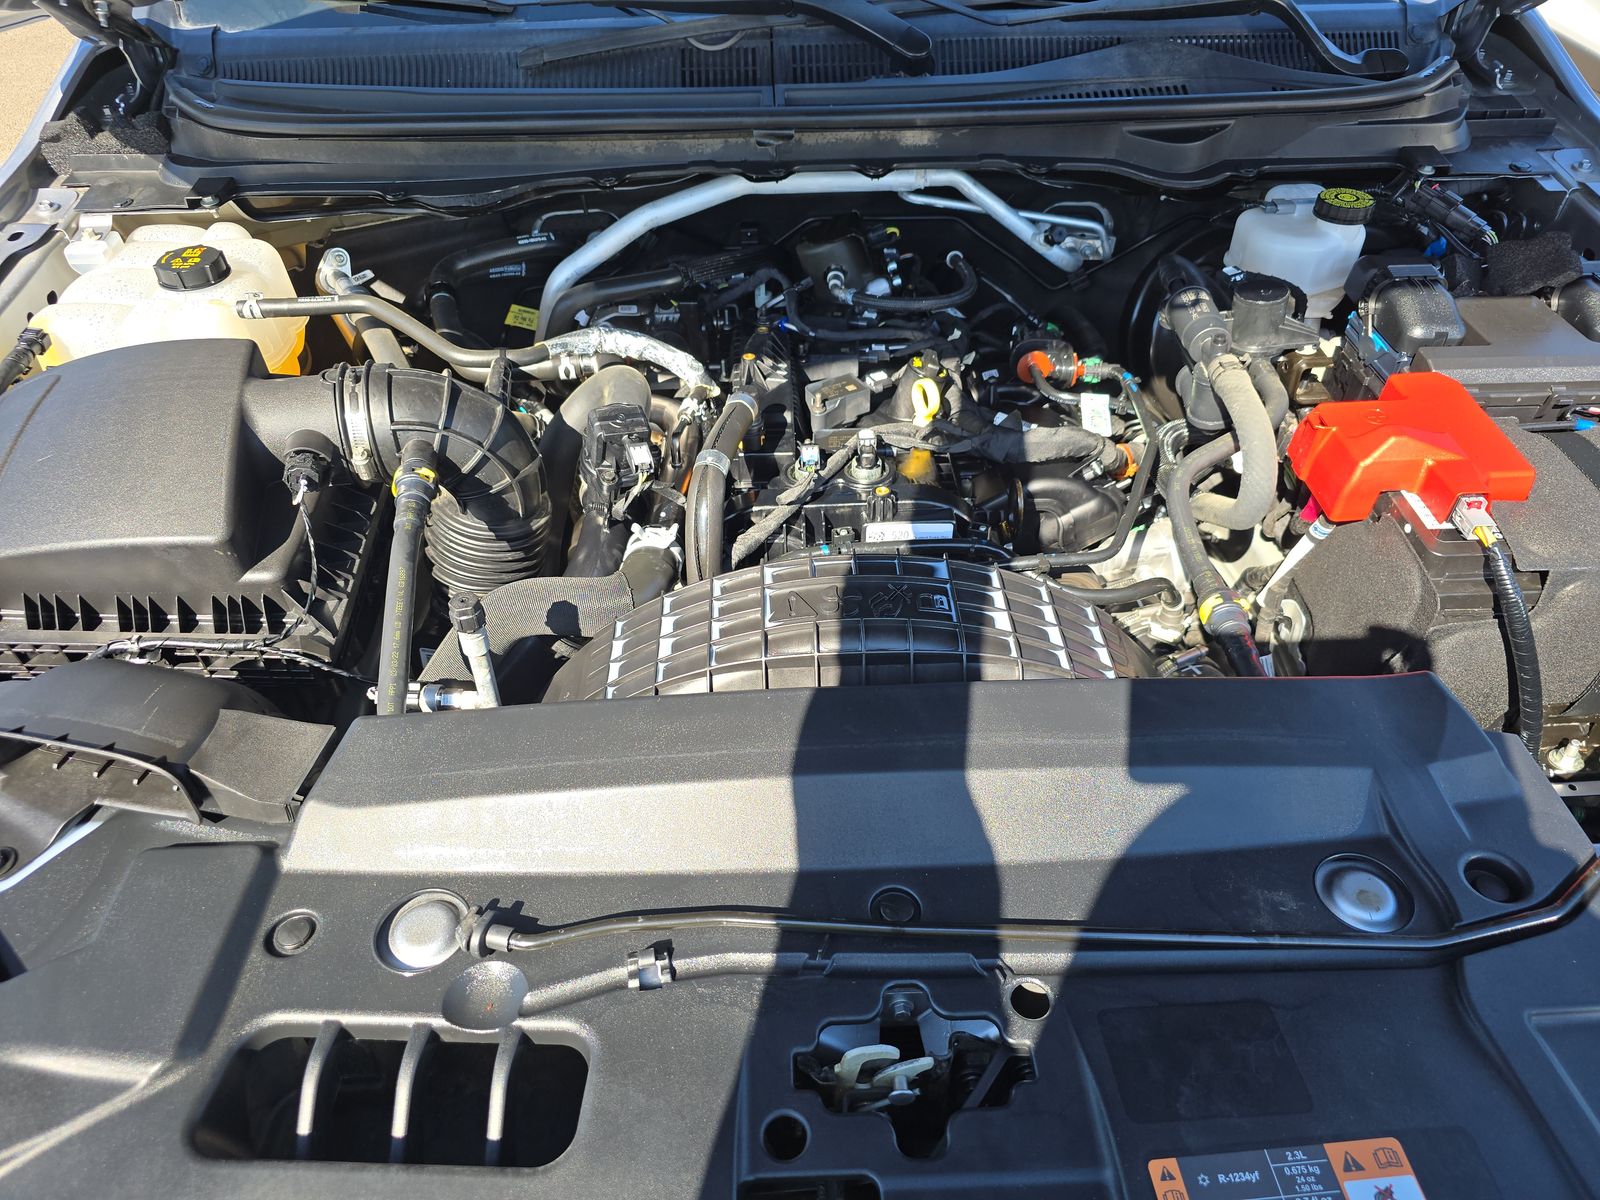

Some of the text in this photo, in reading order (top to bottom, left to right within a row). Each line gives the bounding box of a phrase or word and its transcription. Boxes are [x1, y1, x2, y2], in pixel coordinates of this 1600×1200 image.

[1285, 1150, 1307, 1161] 2.3L
[1284, 1164, 1321, 1176] 0.675 kg
[1217, 1171, 1260, 1183] R-1234yf
